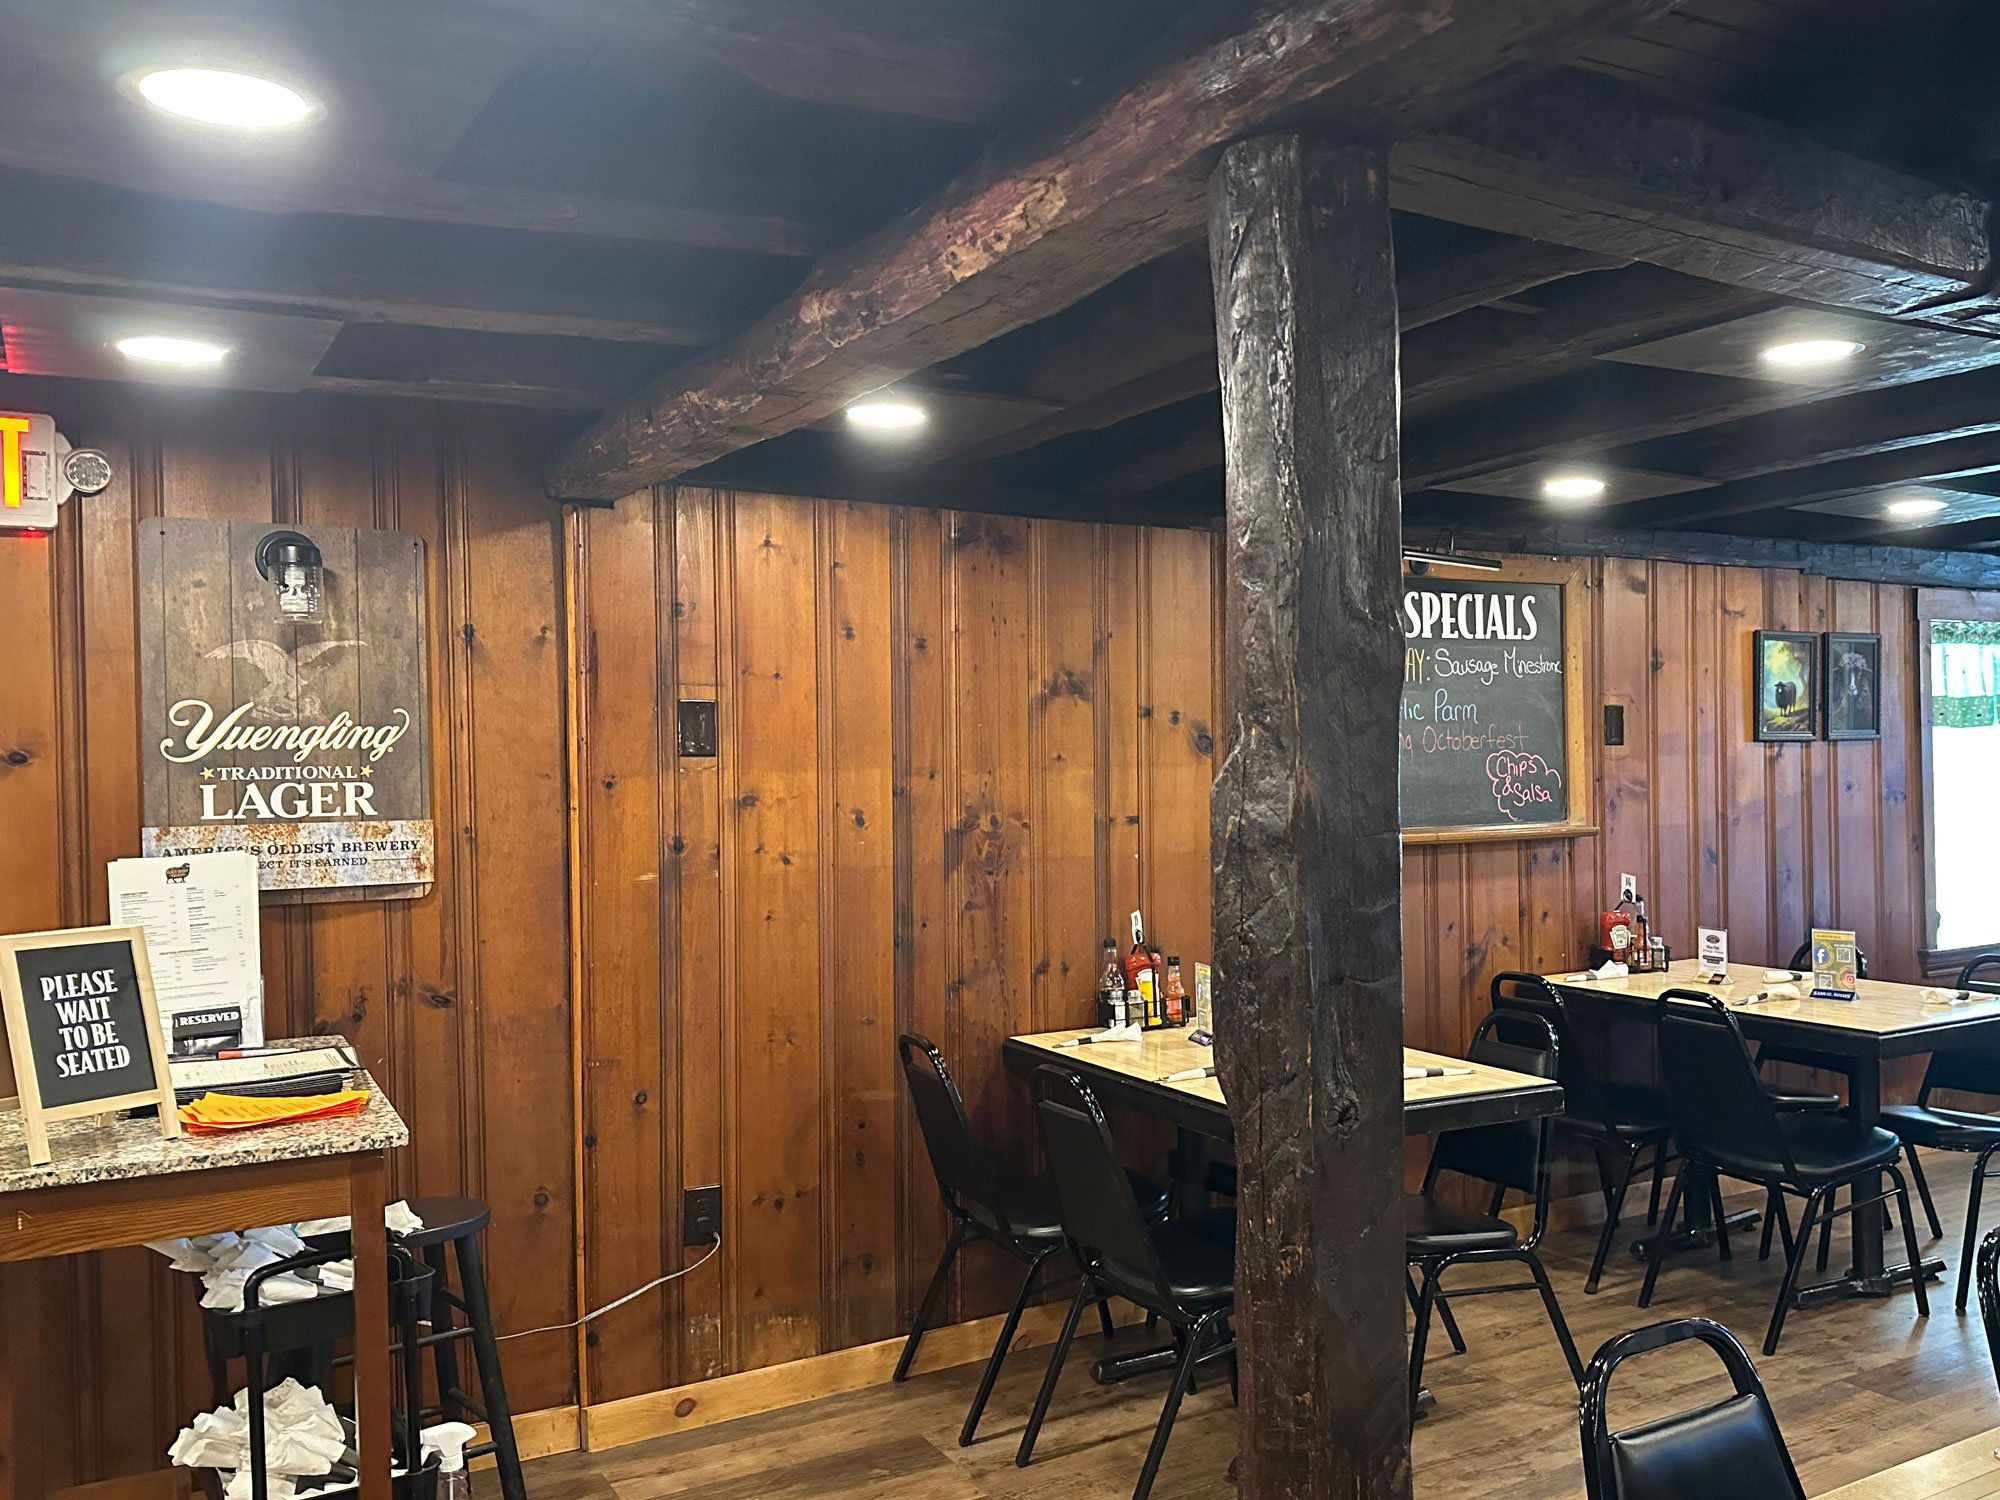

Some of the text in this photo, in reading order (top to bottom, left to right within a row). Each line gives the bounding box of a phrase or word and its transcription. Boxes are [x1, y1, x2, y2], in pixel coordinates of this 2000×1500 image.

[1403, 590, 1538, 641] SPECIALS
[1404, 647, 1431, 685] AY:
[1435, 648, 1499, 685] Sausage
[1400, 688, 1479, 724] lic Parm
[160, 699, 410, 763] Yuengling
[1423, 722, 1530, 754] Octoberfest
[217, 765, 358, 782] TRADITIONAL
[1496, 757, 1538, 778] Chips
[200, 782, 378, 820] LAGER
[1513, 783, 1553, 806] Salsa
[267, 842, 335, 856] OLDEST
[341, 839, 421, 853] BREWERY
[289, 859, 312, 868] IT'S
[315, 857, 368, 867] EARNED
[40, 969, 118, 1001] PLEASE
[55, 996, 110, 1025] WAIT
[179, 1011, 240, 1027] RESERVED
[58, 1020, 119, 1051] TO BE
[56, 1045, 131, 1078] SEATED
